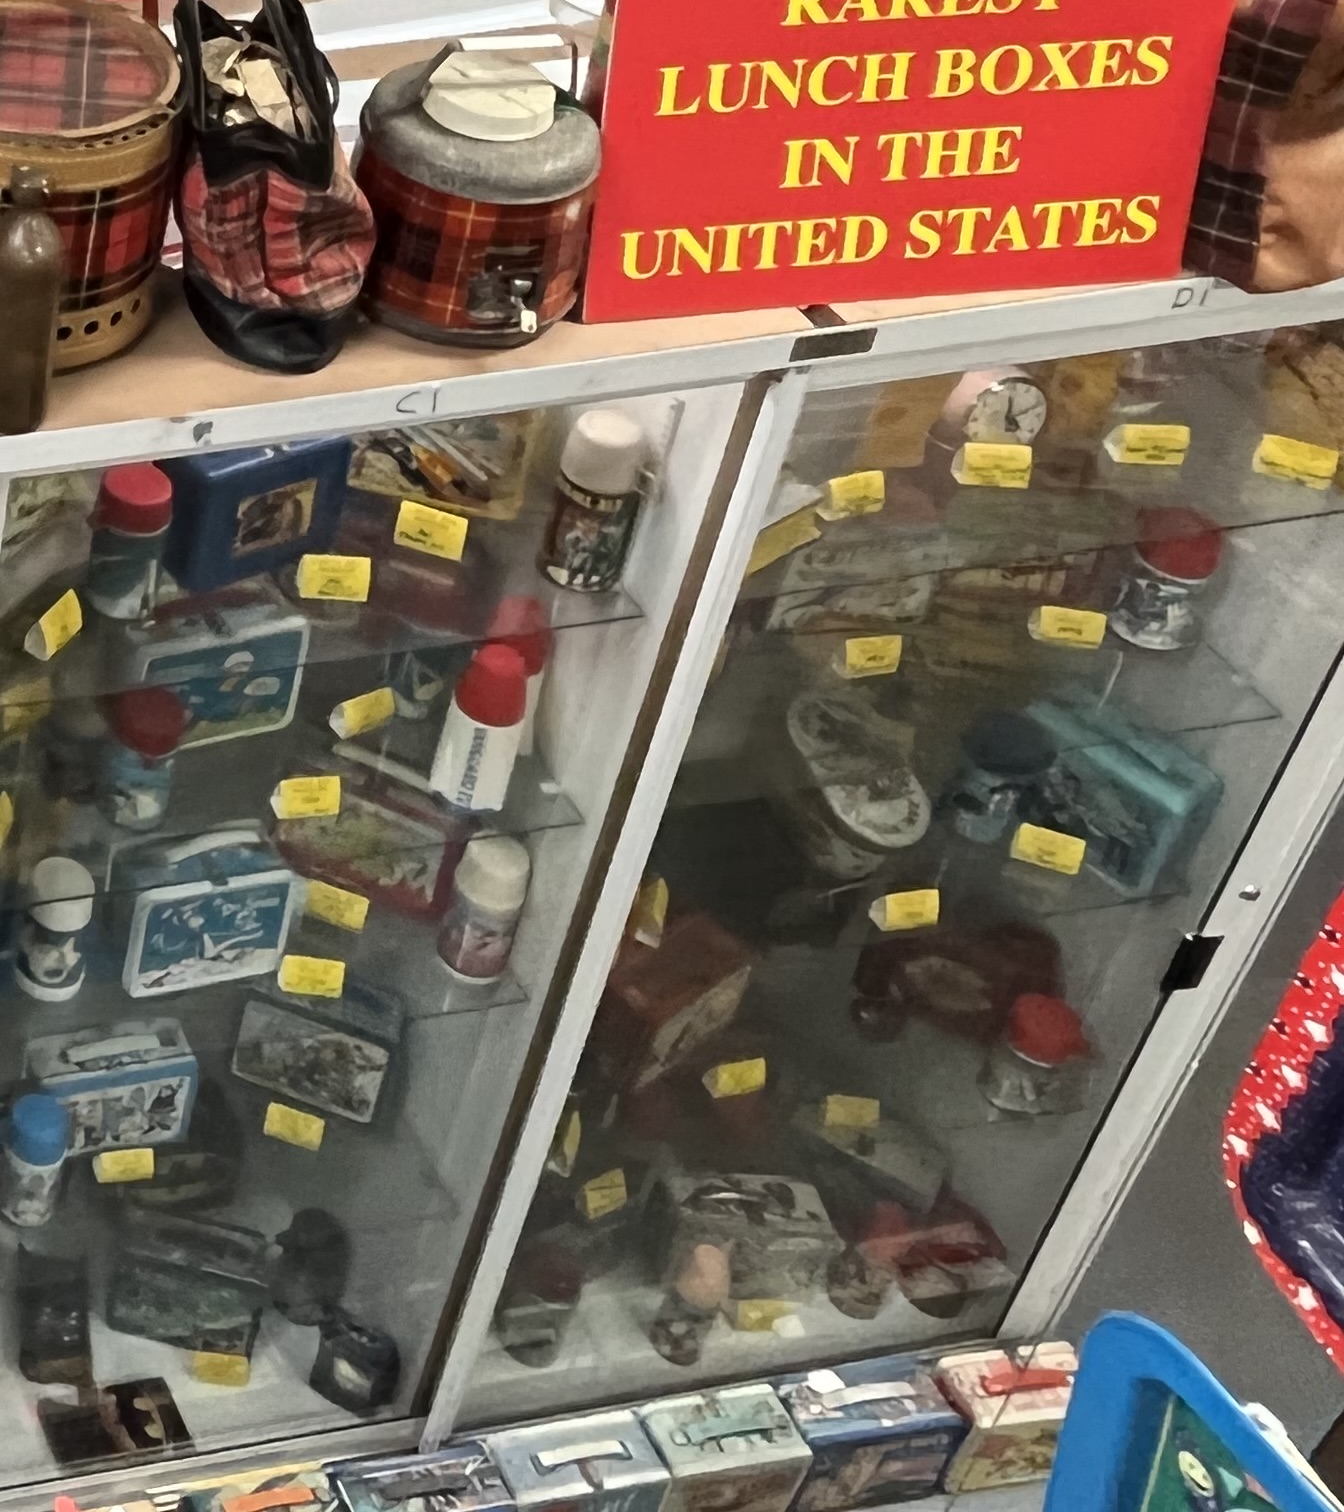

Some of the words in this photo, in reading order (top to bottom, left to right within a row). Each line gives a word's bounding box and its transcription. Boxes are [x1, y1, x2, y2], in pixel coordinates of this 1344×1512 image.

[654, 50, 915, 117] LUNCH
[931, 35, 1174, 99] BOXES
[778, 136, 860, 189] IN
[878, 125, 1023, 182] THE
[620, 216, 889, 281] UNITED
[904, 195, 1162, 260] STATES
